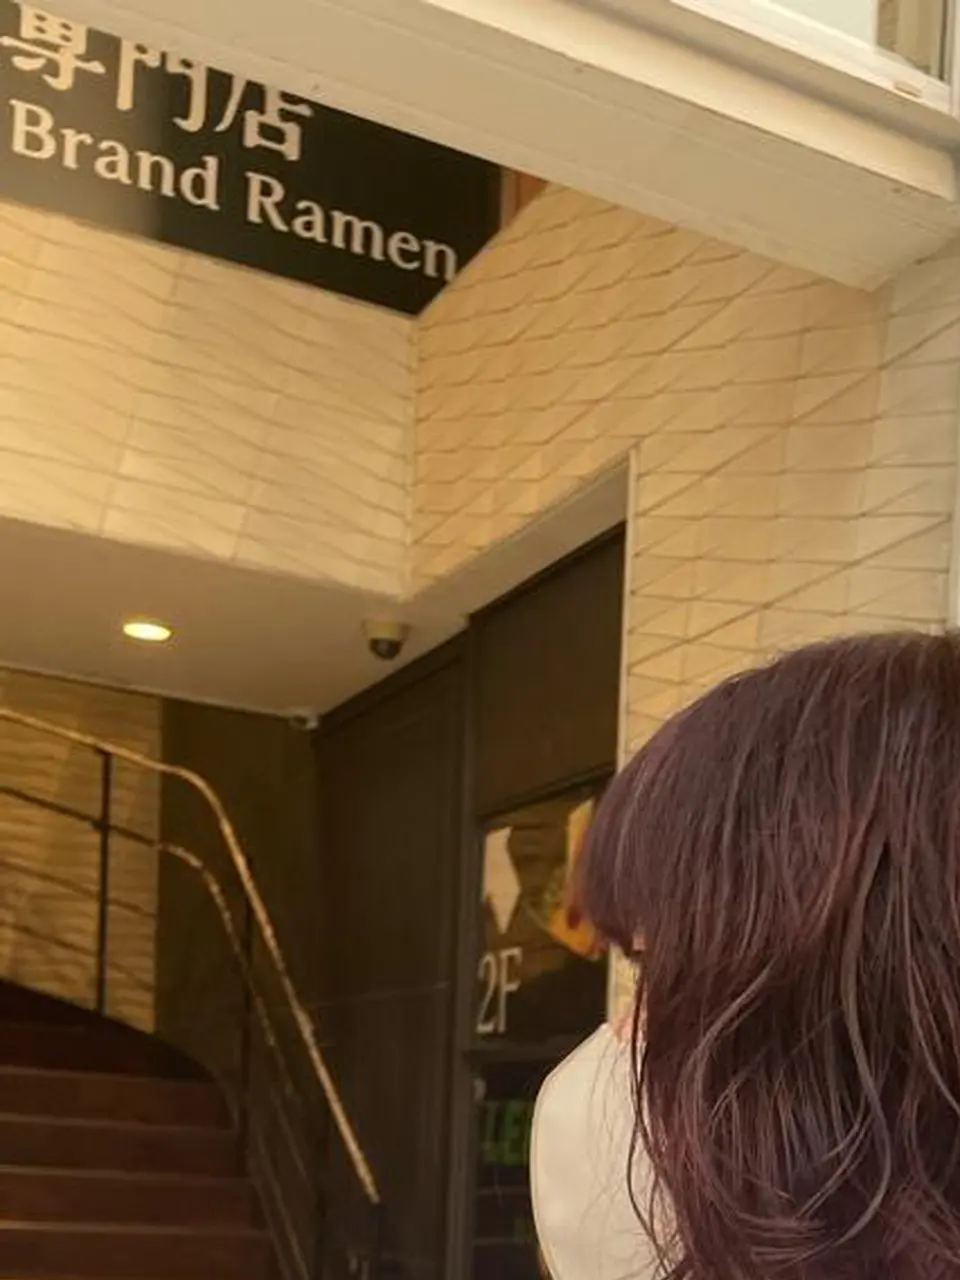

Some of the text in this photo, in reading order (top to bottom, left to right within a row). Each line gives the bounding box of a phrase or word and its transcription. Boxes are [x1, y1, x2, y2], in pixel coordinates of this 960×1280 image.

[7, 97, 458, 283] Brand Ramen
[476, 946, 523, 1035] 2F
